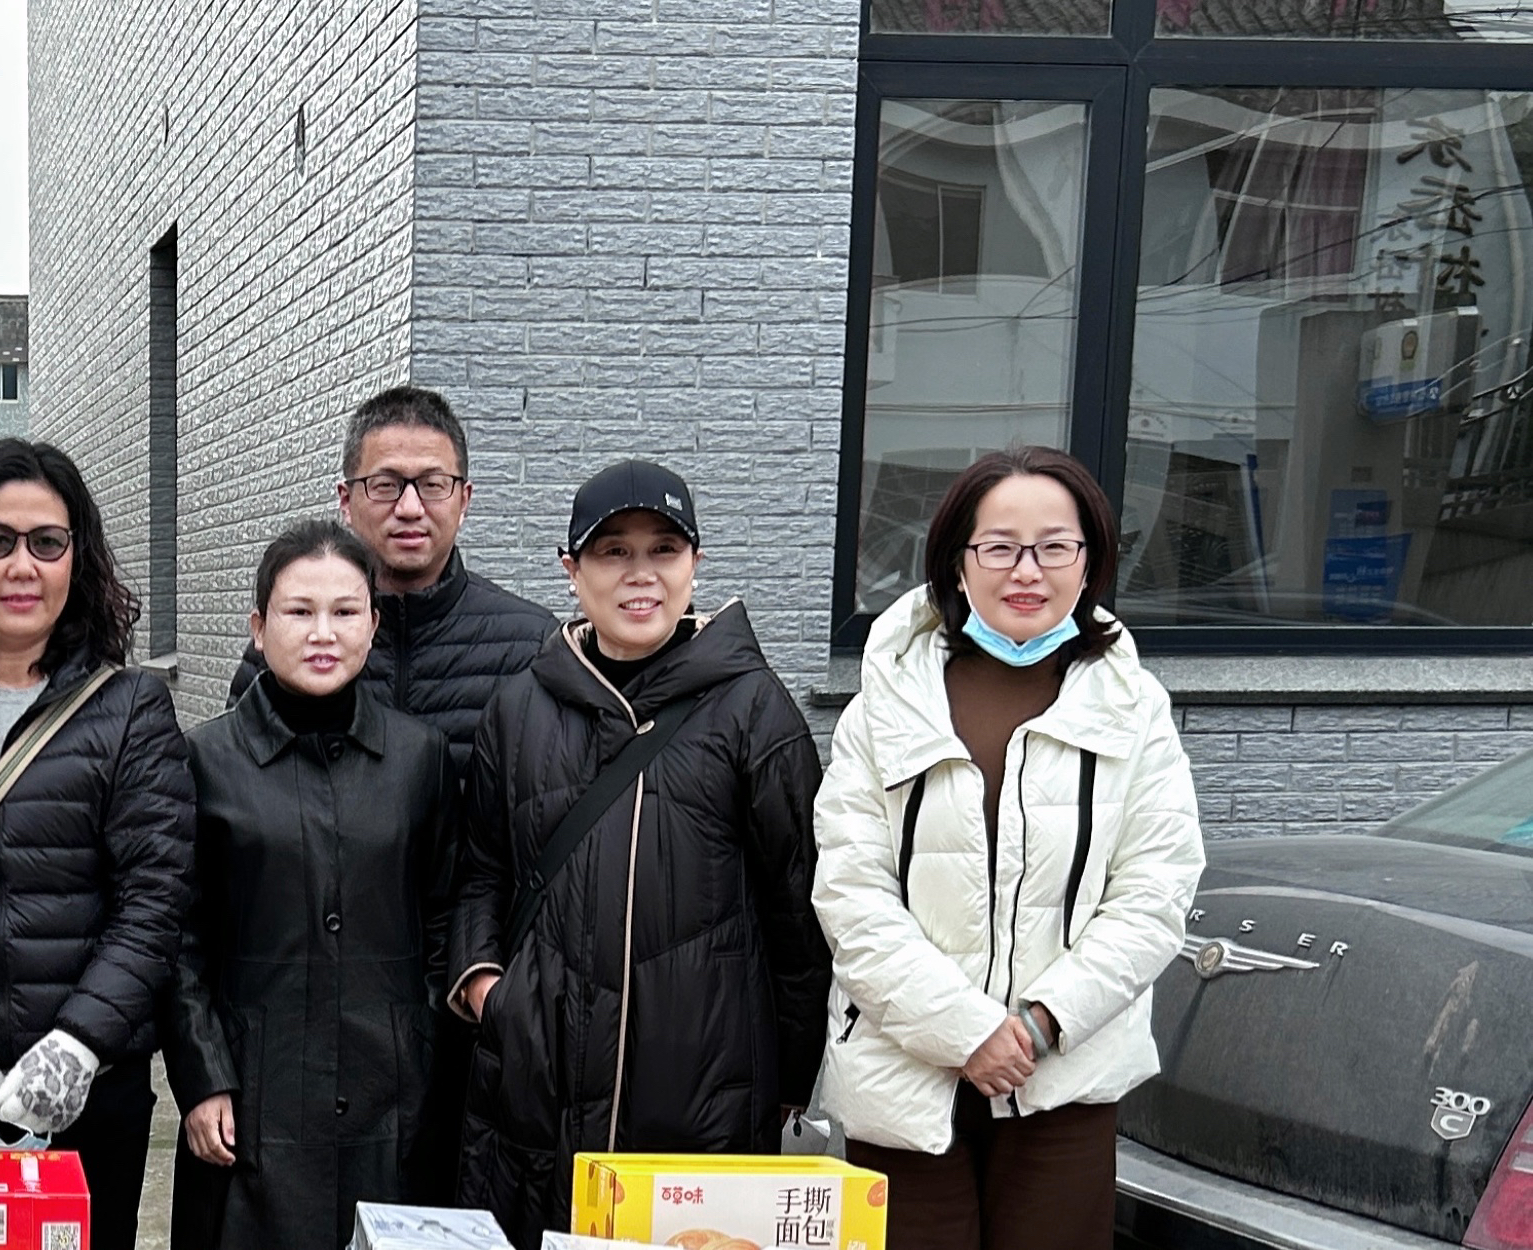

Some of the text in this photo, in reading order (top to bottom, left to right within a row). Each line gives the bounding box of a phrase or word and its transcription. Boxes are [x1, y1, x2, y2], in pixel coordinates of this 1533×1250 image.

[1430, 1086, 1491, 1115] 300
[1439, 1114, 1464, 1132] C
[661, 1186, 704, 1205] 百草味
[776, 1187, 831, 1216] 手撕
[775, 1215, 830, 1248] 面包
